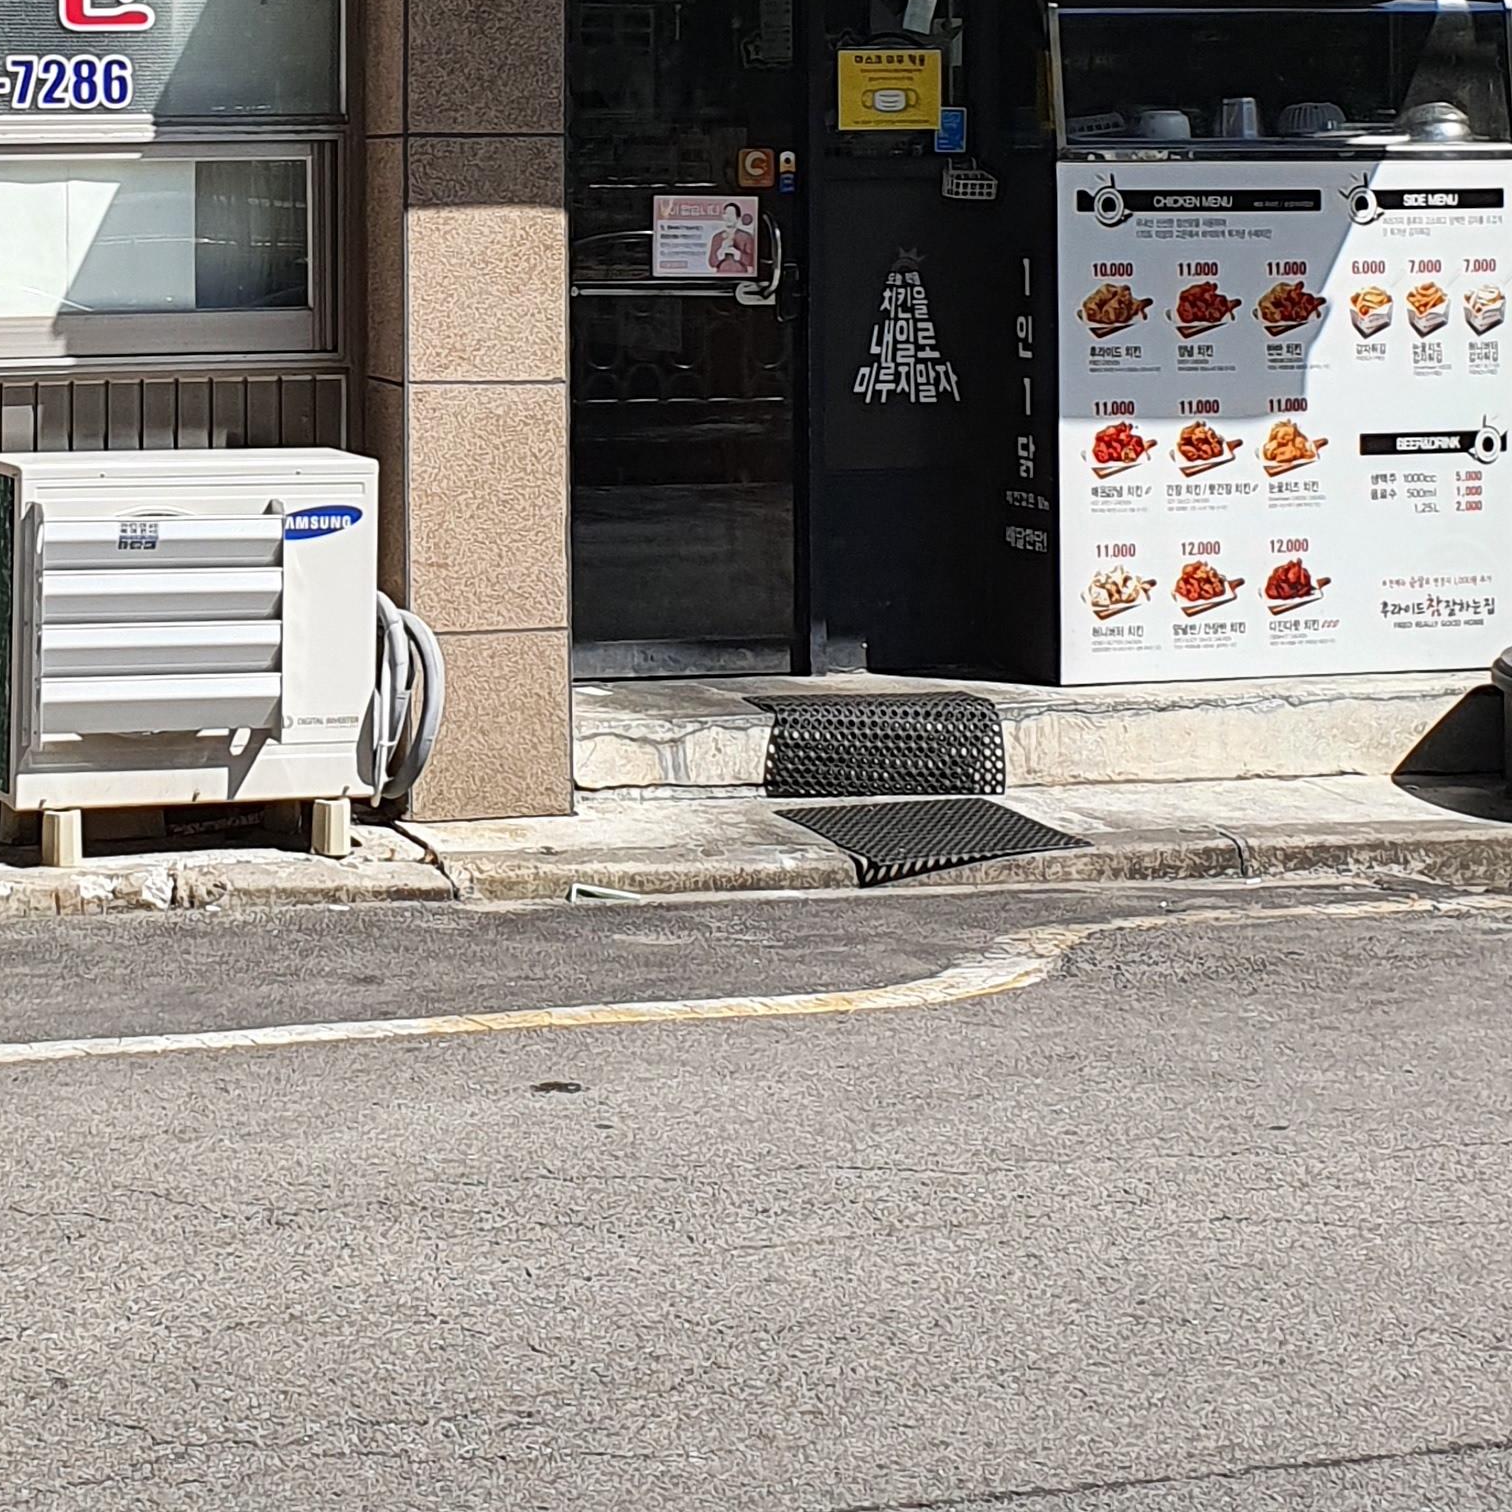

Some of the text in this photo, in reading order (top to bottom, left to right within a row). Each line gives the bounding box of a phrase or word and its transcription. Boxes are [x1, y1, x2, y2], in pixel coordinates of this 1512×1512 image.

[1153, 195, 1234, 209] CHICKEN MENU
[1403, 193, 1459, 207] SIDE MENU
[1177, 261, 1219, 277] 11,000
[1266, 260, 1308, 277] 11,000
[879, 285, 931, 321] 치킨을
[868, 319, 942, 364] 내일로
[1125, 344, 1143, 359] 치킨
[1196, 344, 1215, 358] 치킨
[852, 361, 962, 405] 미루지말자
[1093, 399, 1136, 416] 11,000
[1178, 398, 1220, 415] 11,000
[1267, 397, 1309, 414] 11,000
[285, 515, 352, 530] AMSUNG
[1096, 543, 1137, 558] 11,000
